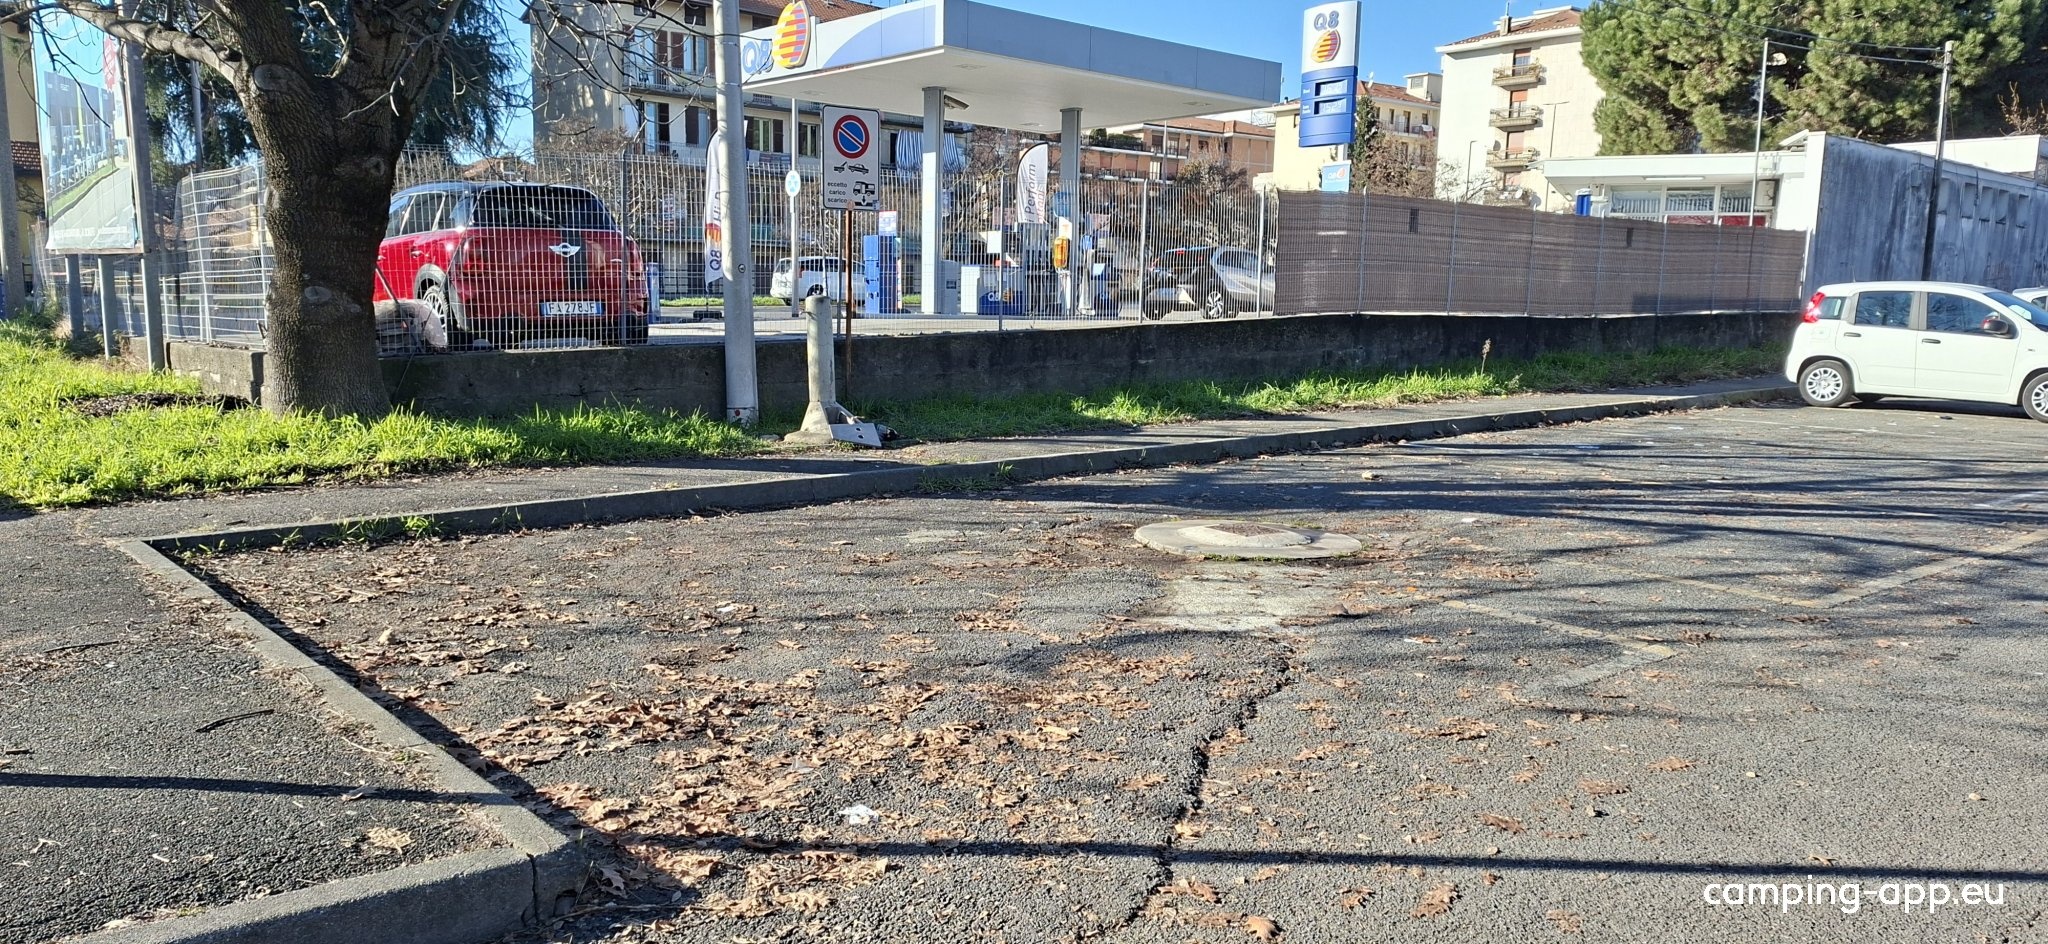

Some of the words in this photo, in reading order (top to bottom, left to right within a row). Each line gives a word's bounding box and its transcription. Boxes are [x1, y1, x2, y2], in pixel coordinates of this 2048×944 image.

[1314, 10, 1340, 31] Q8
[742, 40, 774, 75] Q8
[1024, 164, 1037, 215] Perform
[709, 249, 722, 271] Q8
[565, 303, 595, 313] 278JF
